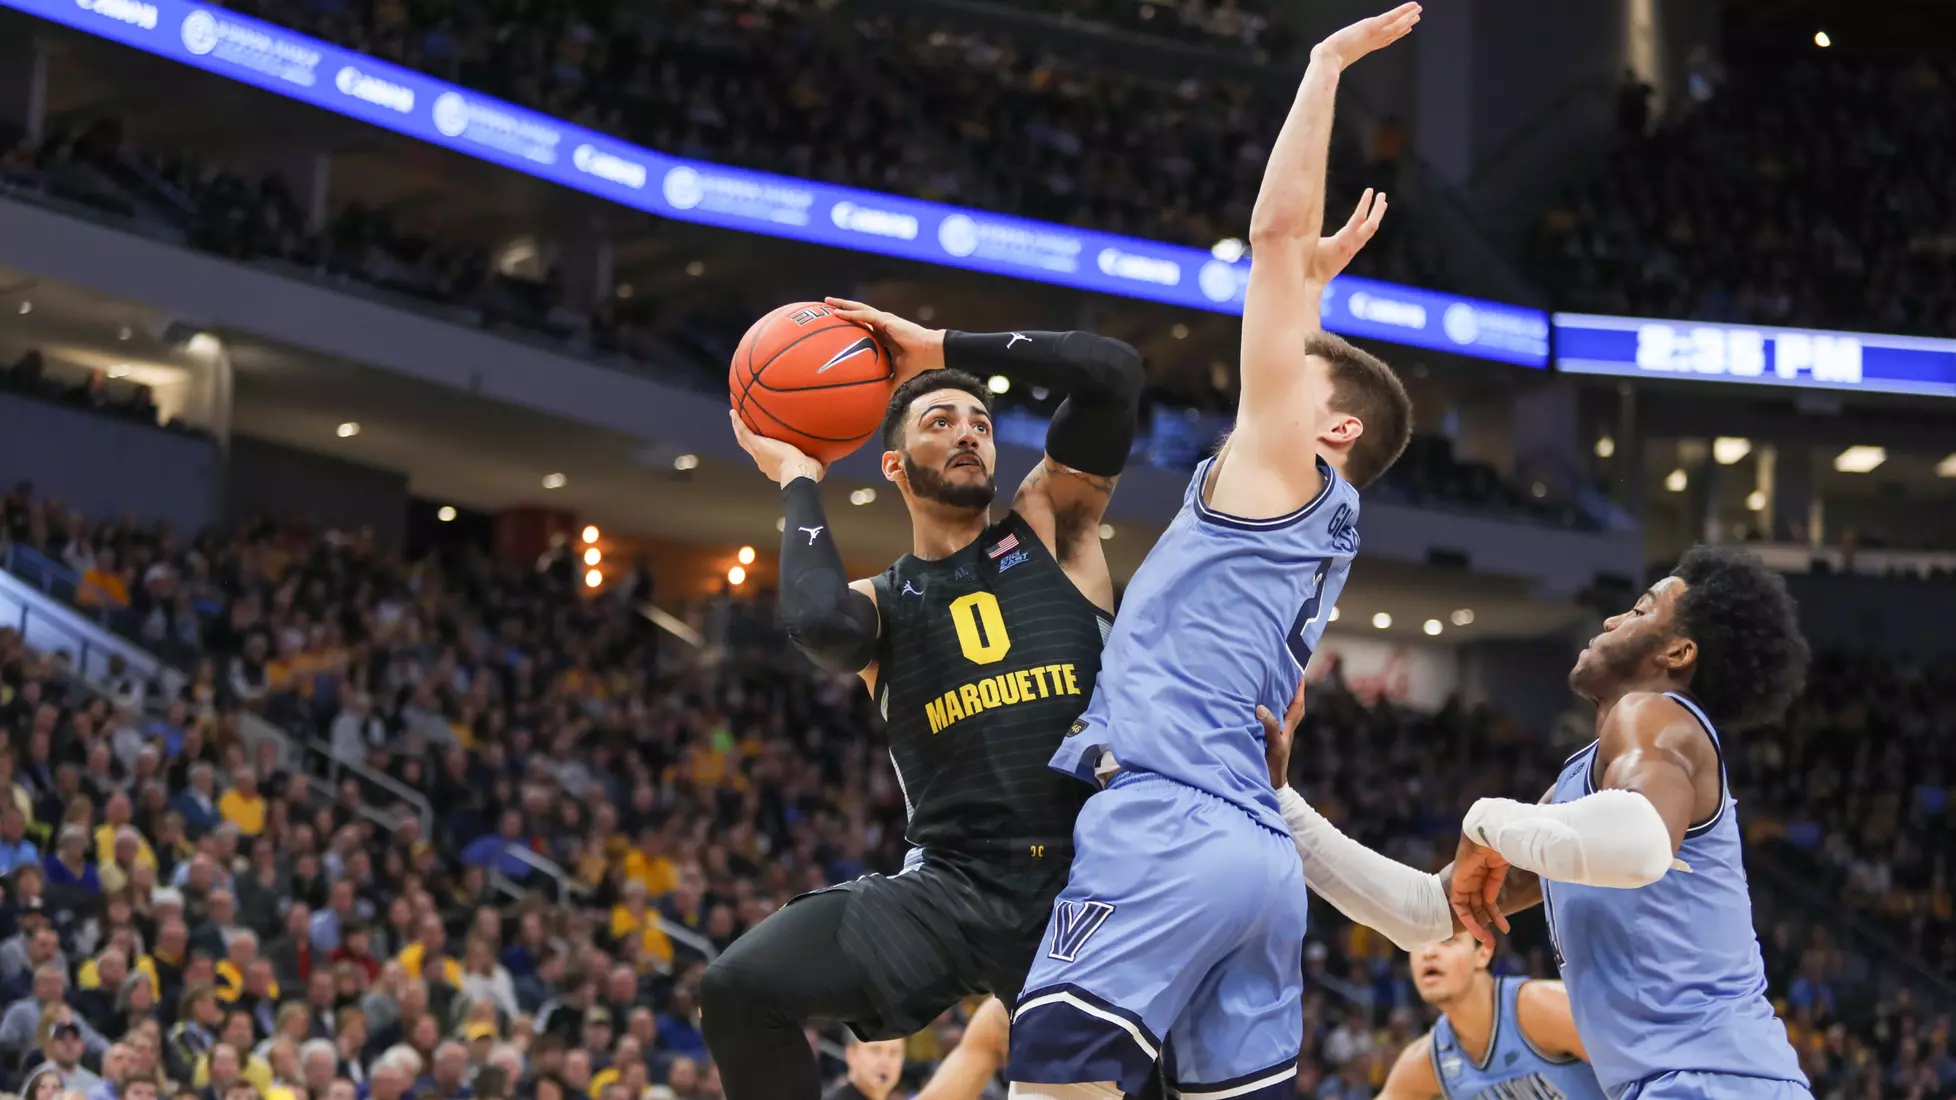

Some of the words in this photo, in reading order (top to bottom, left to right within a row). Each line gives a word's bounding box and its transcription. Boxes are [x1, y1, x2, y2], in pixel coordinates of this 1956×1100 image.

[1775, 333, 1863, 383] PM
[949, 591, 1011, 665] 0
[925, 663, 1081, 734] MARQUETTE
[1047, 900, 1115, 962] V
